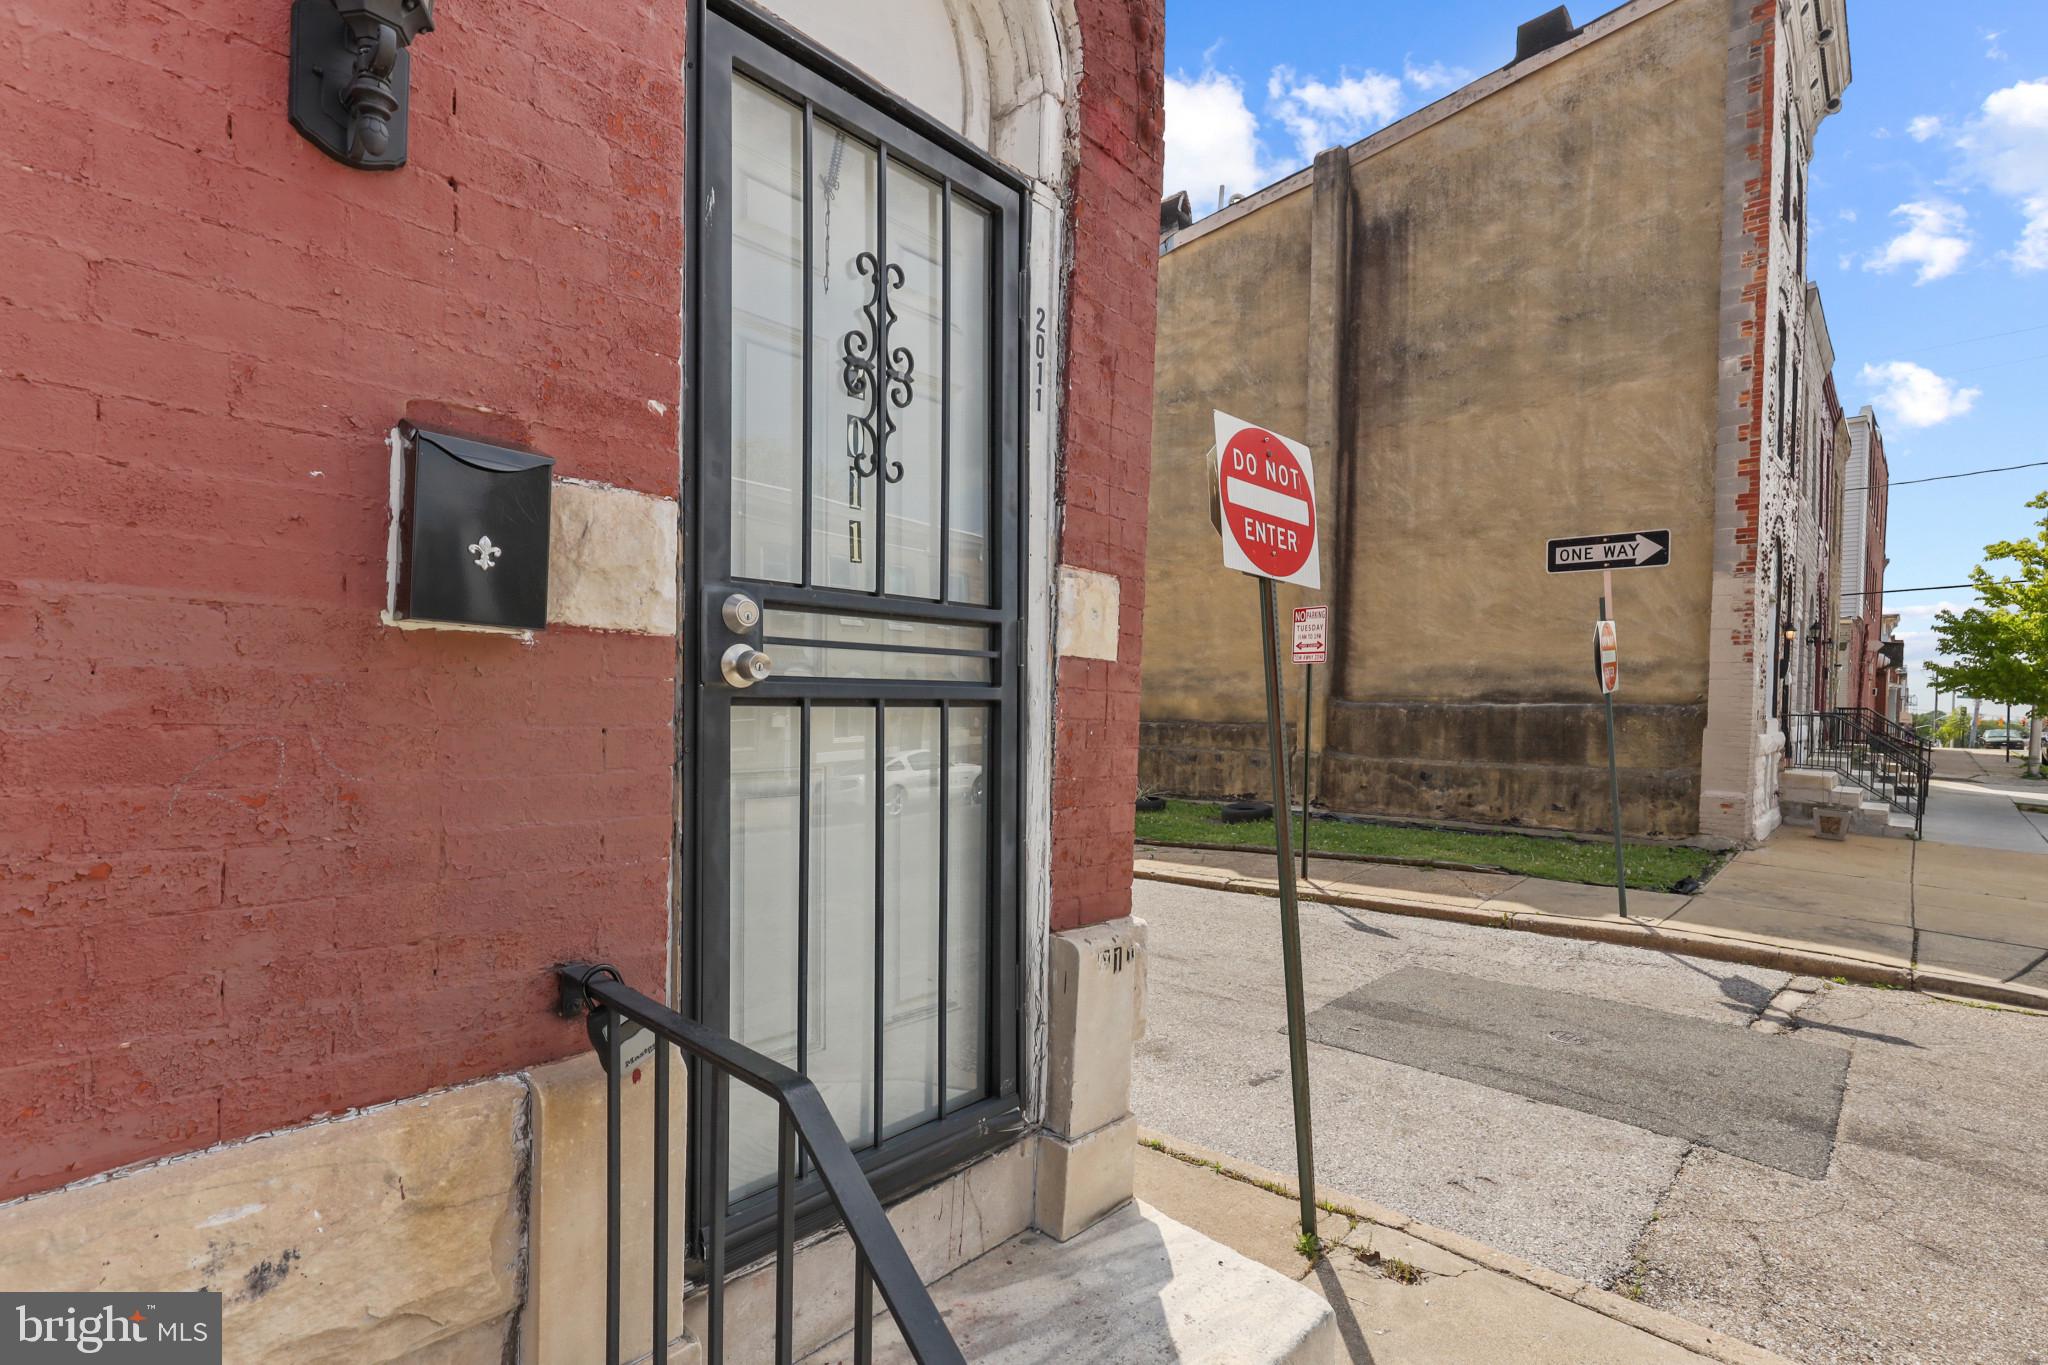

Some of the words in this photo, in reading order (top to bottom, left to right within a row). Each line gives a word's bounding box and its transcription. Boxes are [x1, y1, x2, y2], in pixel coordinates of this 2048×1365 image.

[1035, 307, 1046, 412] 2011
[1232, 447, 1257, 475] DO
[1265, 459, 1299, 491] NOT
[1244, 518, 1298, 552] ENTER
[1559, 547, 1594, 562] ONE
[1603, 543, 1641, 558] WAY
[1295, 611, 1306, 622] NO
[1306, 610, 1326, 619] PARKING
[1296, 624, 1324, 632] TUESDAY
